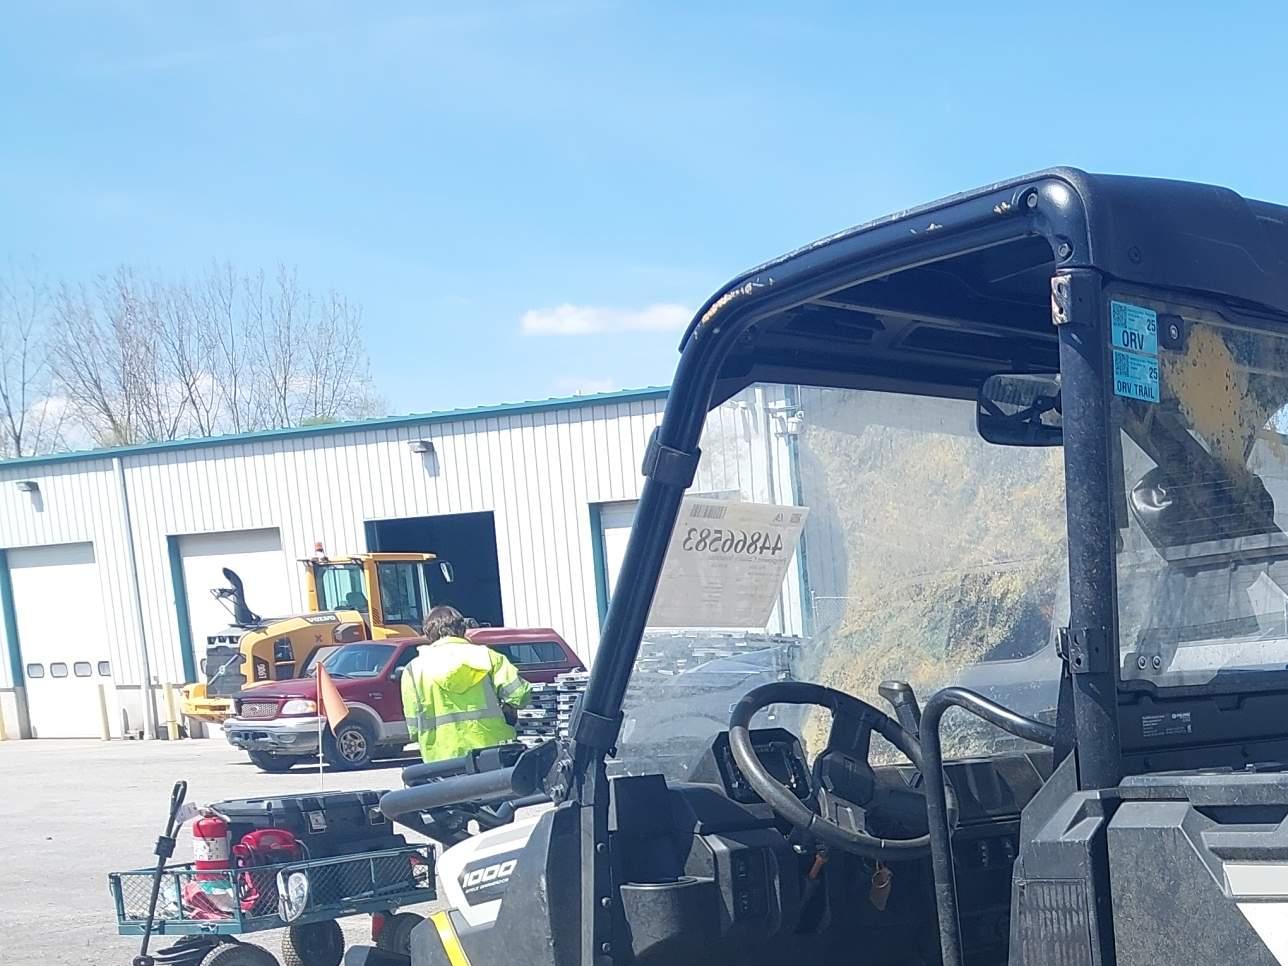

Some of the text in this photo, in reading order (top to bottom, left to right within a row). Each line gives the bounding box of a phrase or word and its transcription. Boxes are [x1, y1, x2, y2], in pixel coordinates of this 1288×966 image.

[1146, 319, 1156, 332] 25
[1121, 330, 1145, 350] ORV
[1148, 367, 1158, 380] 25
[1116, 380, 1155, 399] ORV TRAIL
[462, 859, 518, 889] 1000
